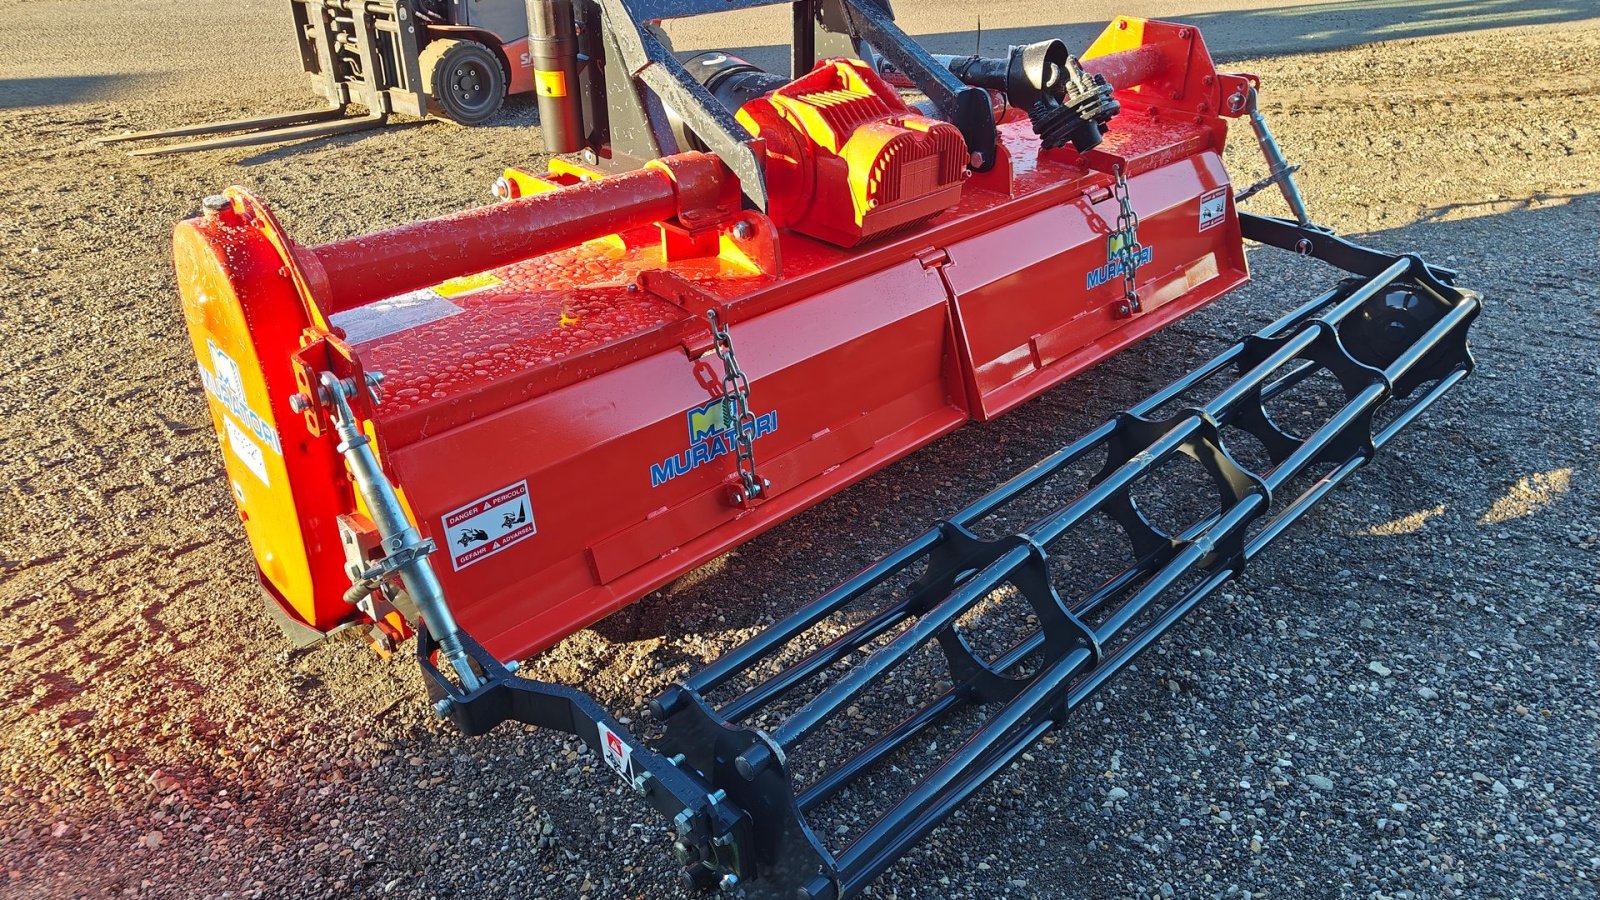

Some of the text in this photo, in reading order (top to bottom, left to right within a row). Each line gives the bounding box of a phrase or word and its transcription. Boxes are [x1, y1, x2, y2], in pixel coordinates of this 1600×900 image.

[1086, 245, 1152, 291] MURAORI
[449, 486, 525, 524] DANGER PERICOLO
[460, 525, 532, 563] GEFAHR ADVARSEL
